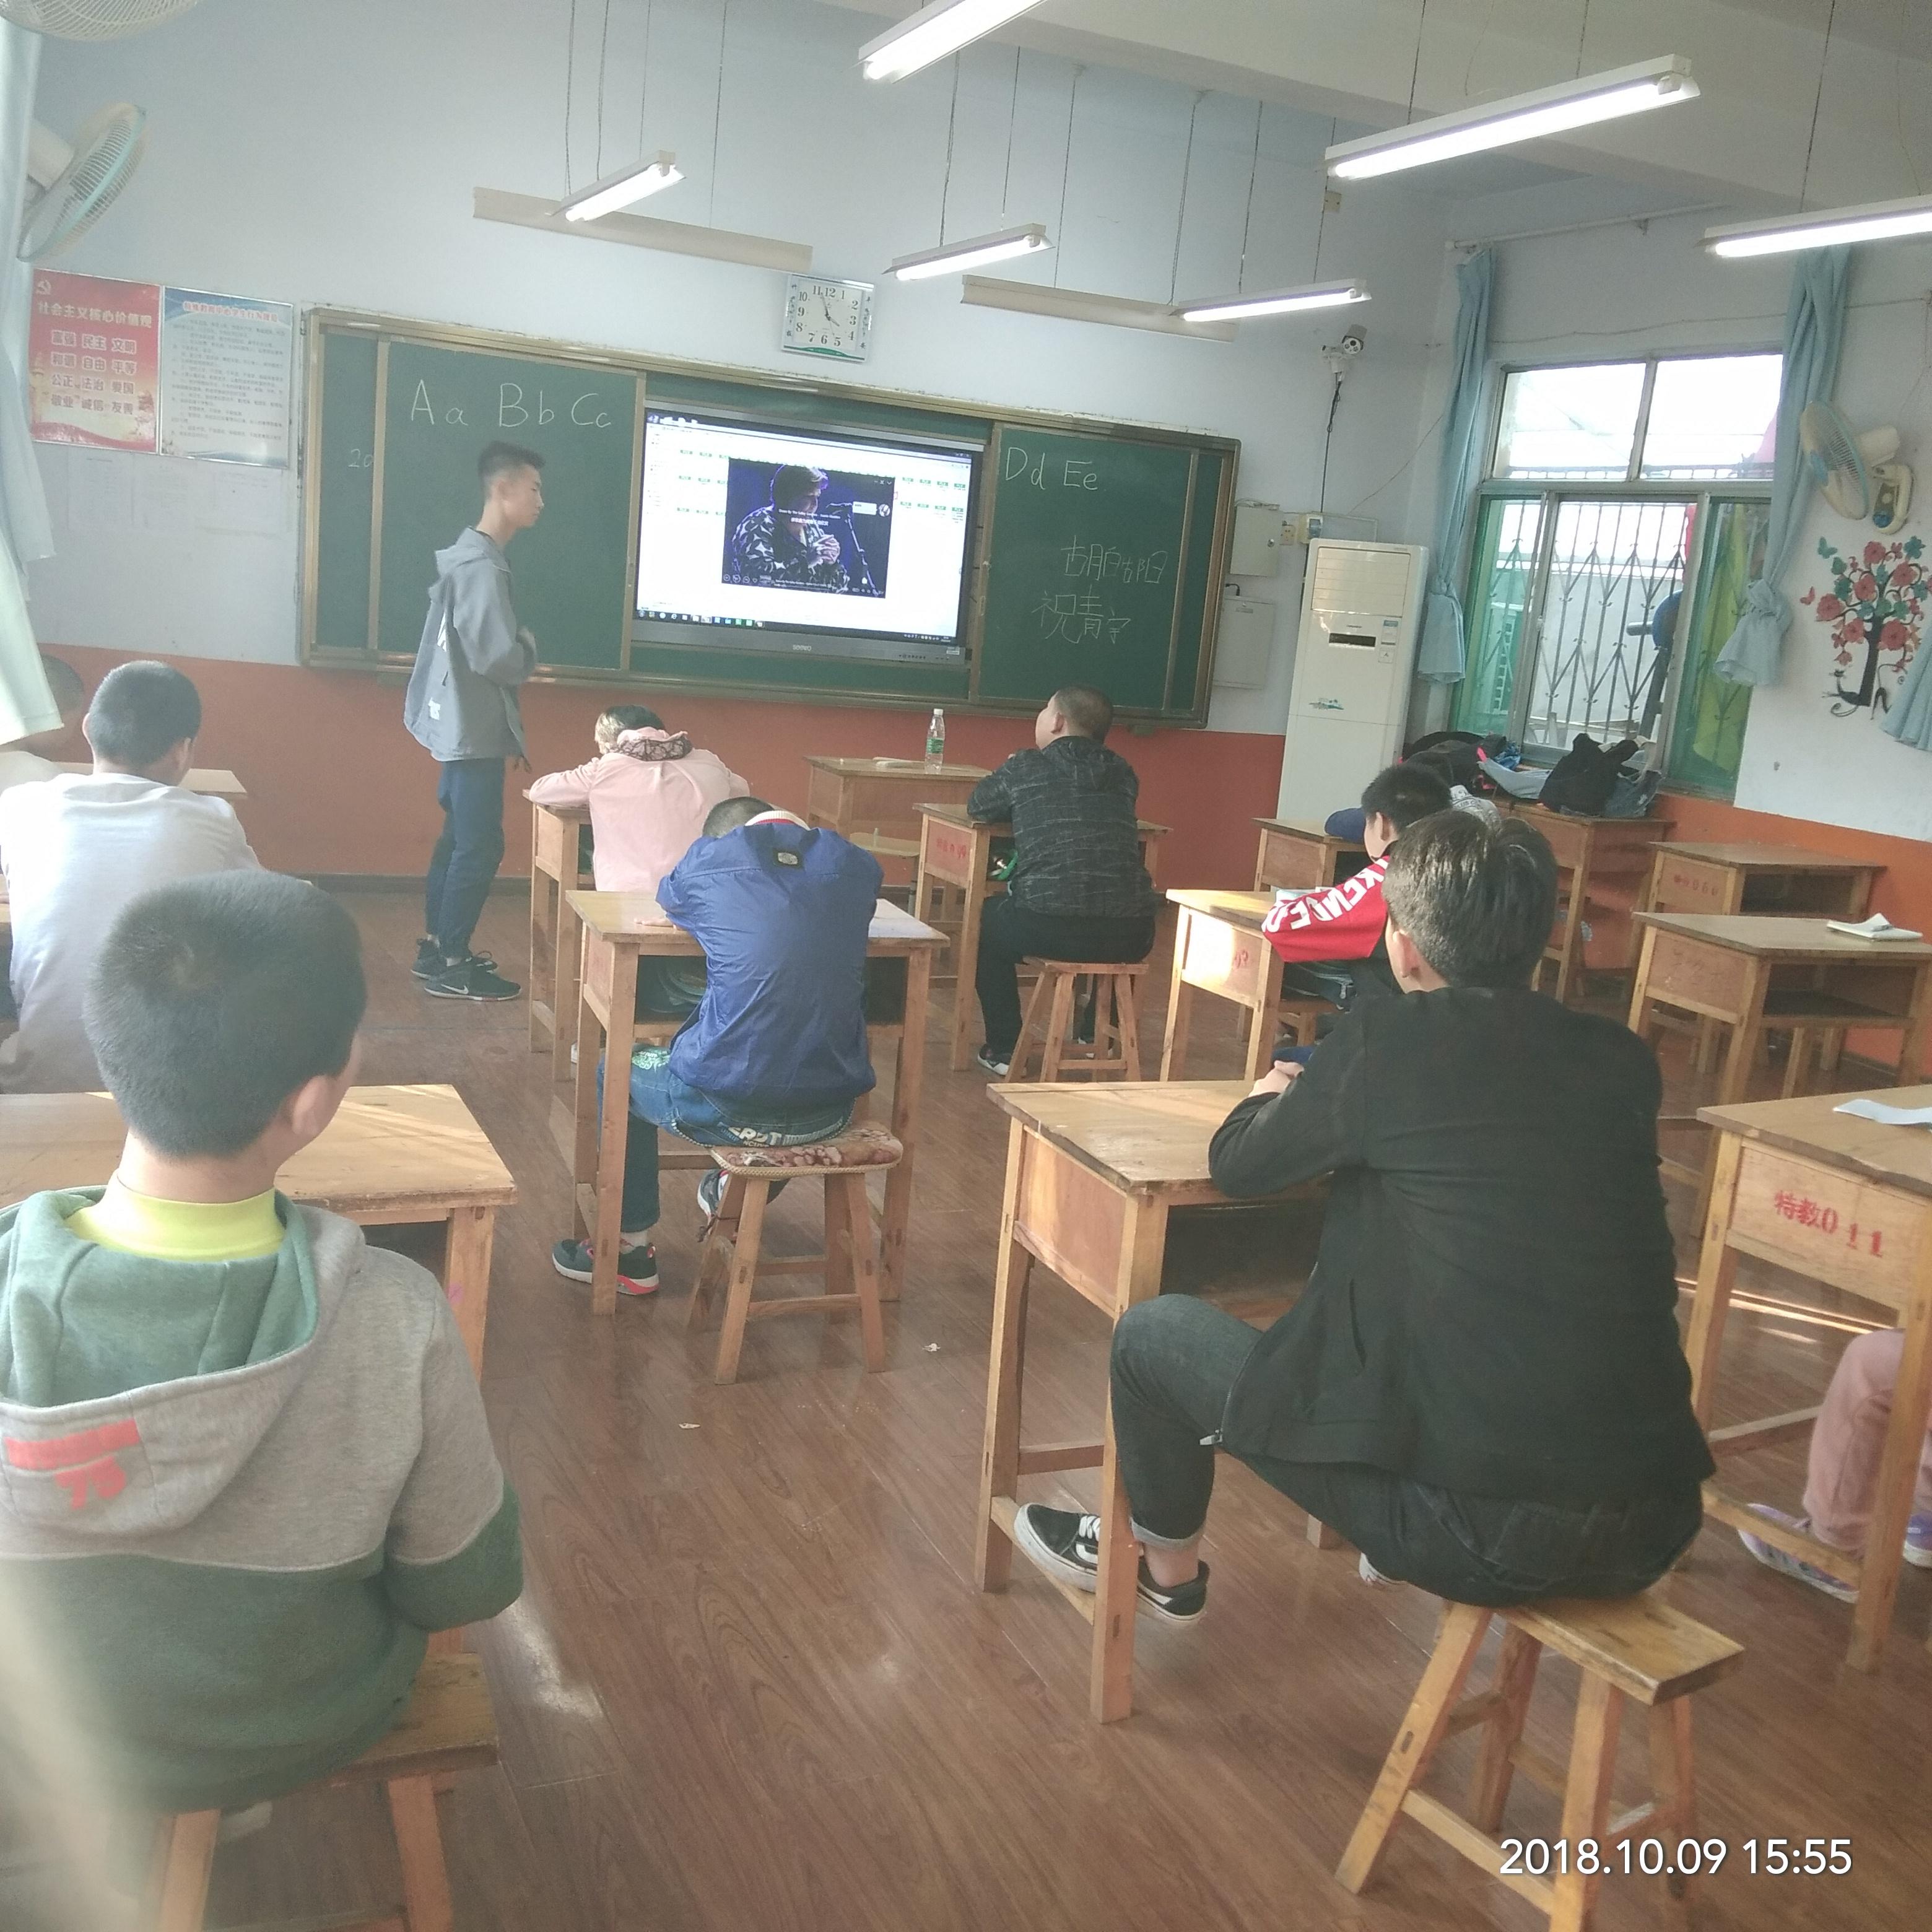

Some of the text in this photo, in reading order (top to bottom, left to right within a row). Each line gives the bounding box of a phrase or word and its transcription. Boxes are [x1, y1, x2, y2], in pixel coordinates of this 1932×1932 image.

[812, 285, 836, 298] 11 12
[840, 290, 845, 300] 1
[798, 292, 807, 302] 10
[851, 300, 859, 310] 2
[38, 302, 152, 328] 社会主义核心价值观
[798, 307, 805, 316] 9
[850, 315, 856, 326] 3
[796, 322, 803, 333] 8
[808, 333, 816, 342] 7
[820, 334, 828, 344] 6
[848, 331, 855, 341] 4
[82, 334, 107, 350] 民主
[111, 338, 136, 354] 文明
[833, 337, 841, 347] 5
[82, 356, 107, 371] 自由
[111, 359, 136, 375] 平等
[52, 374, 134, 394] 公正 法治 爱国
[51, 394, 134, 415] 敬业 诚信 友善
